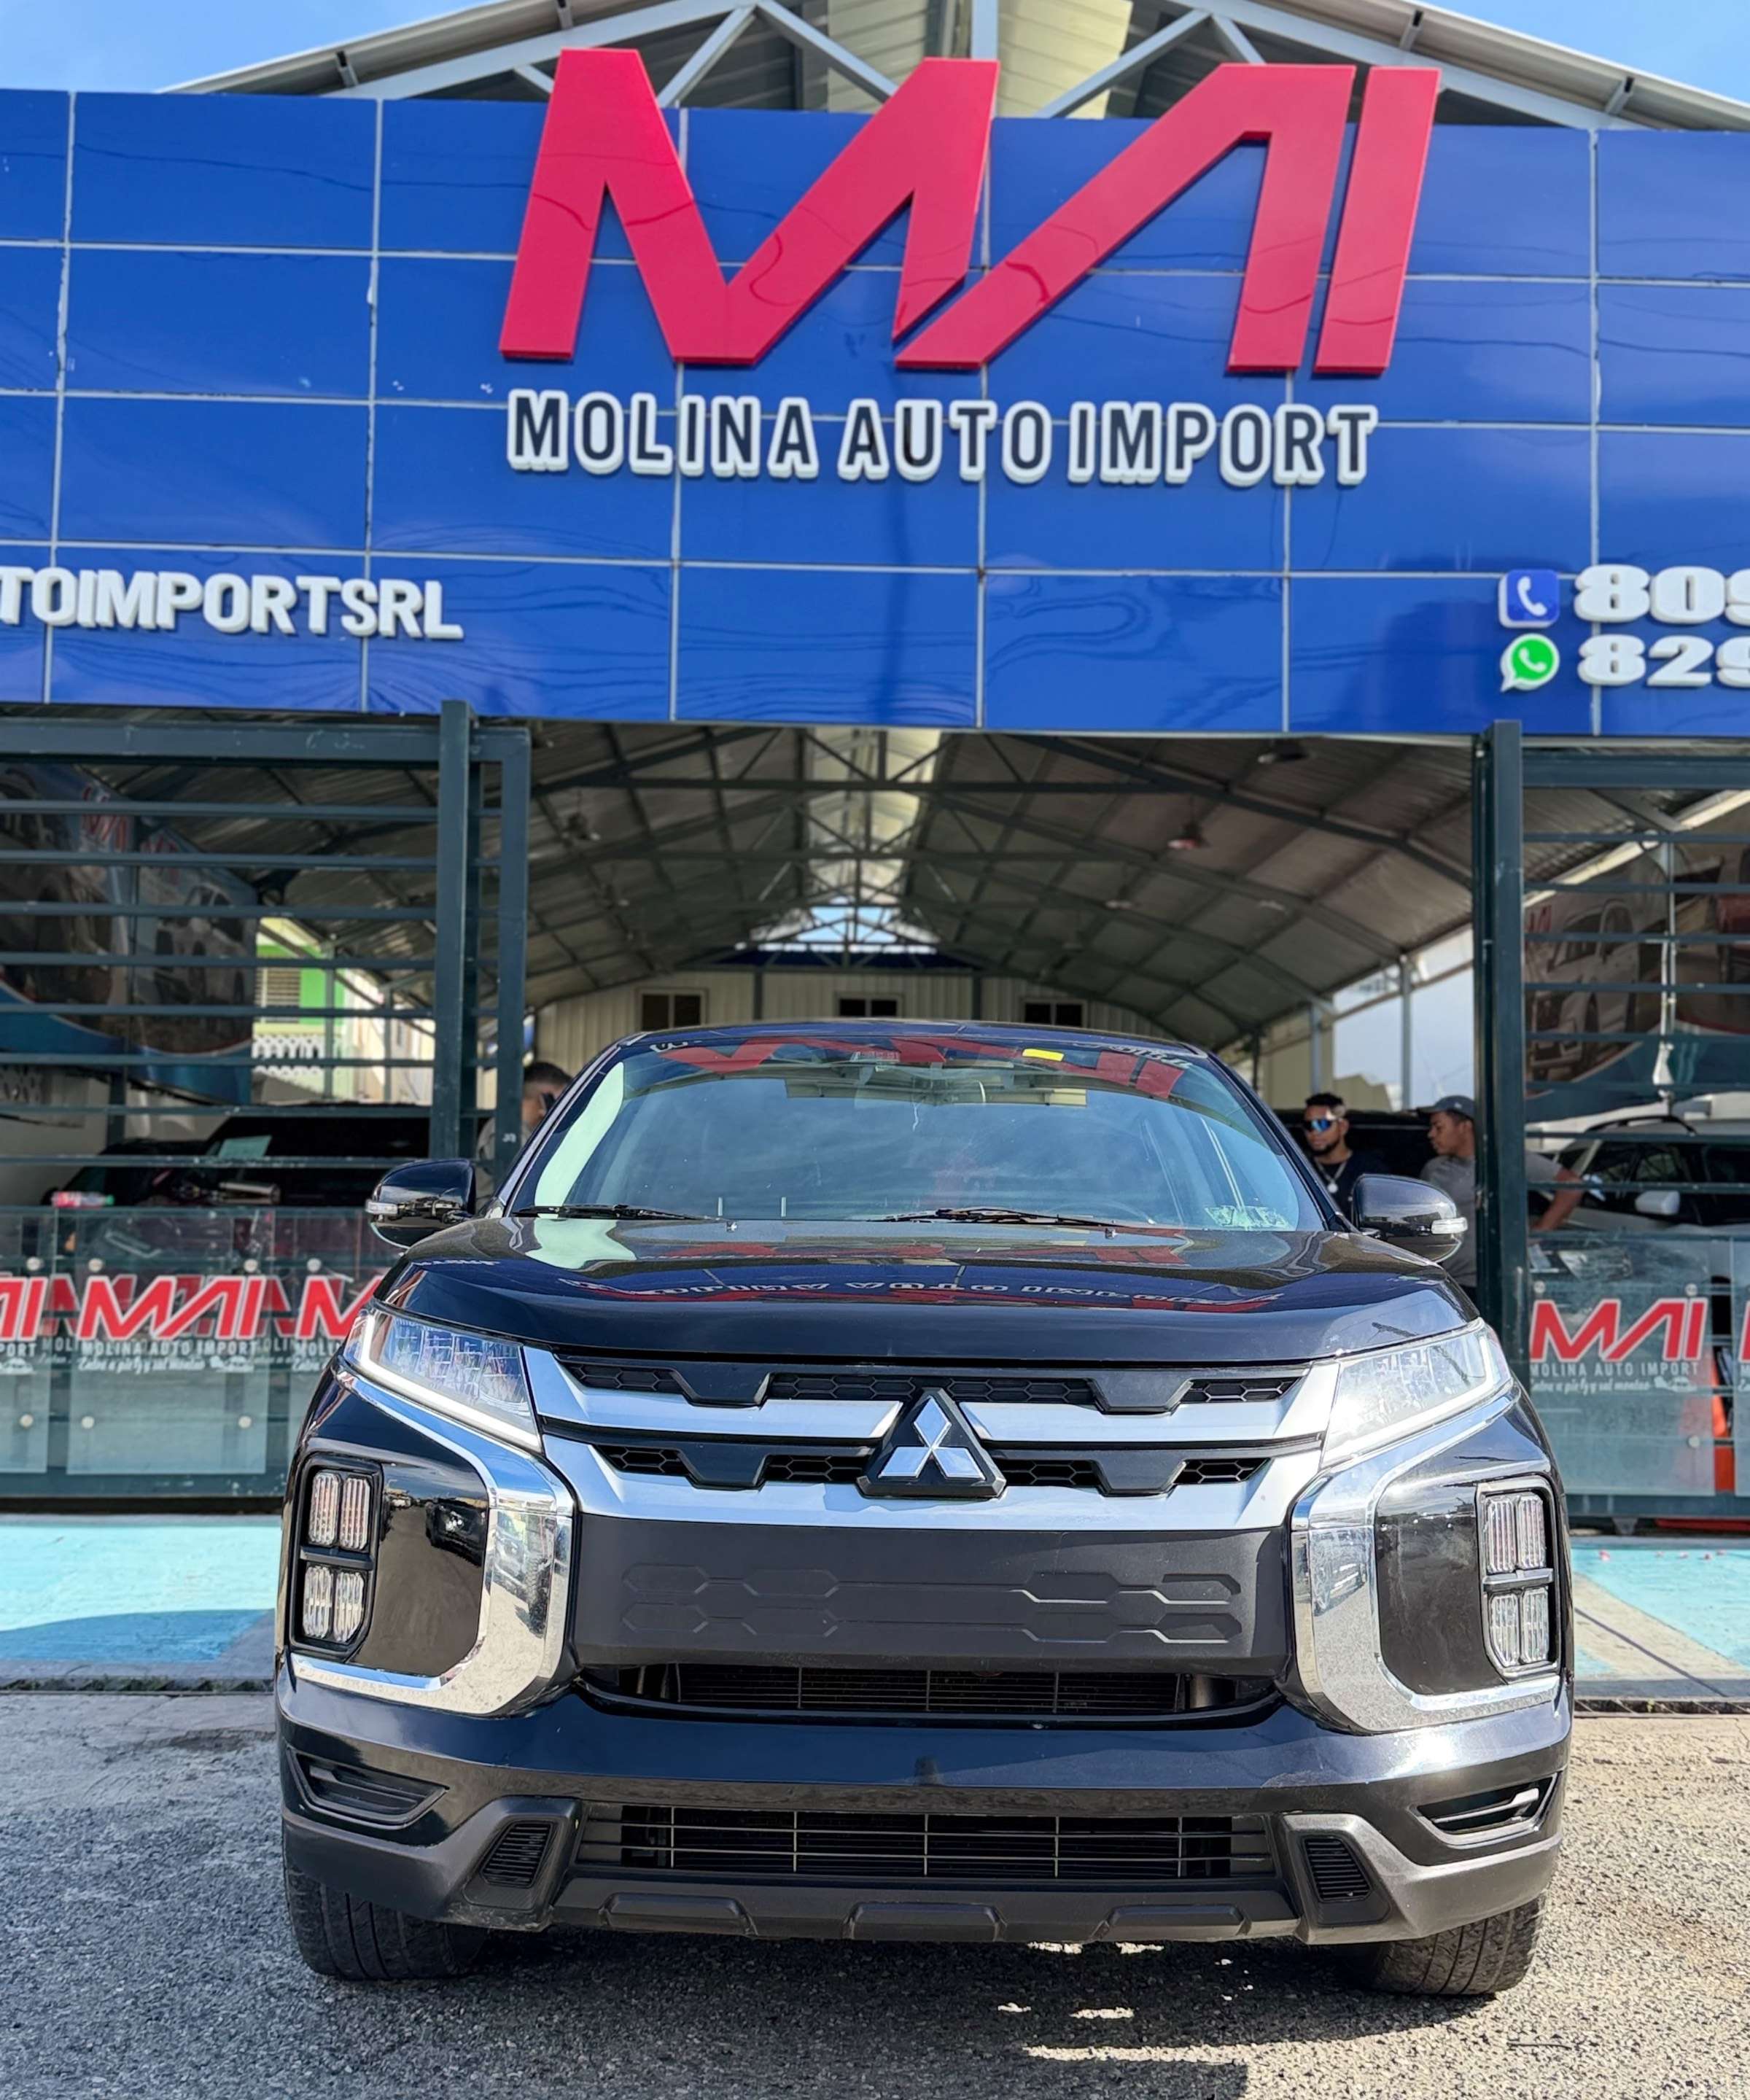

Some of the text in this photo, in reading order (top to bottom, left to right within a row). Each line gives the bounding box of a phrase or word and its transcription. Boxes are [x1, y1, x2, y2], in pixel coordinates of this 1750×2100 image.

[507, 389, 1378, 487] MOLINA AUTO IMPORT
[81, 1340, 142, 1356] MOLINA
[149, 1340, 190, 1356] AUTO
[196, 1340, 258, 1356] IMPORT
[1530, 1361, 1700, 1377] MOLINA AUTO IMPORT
